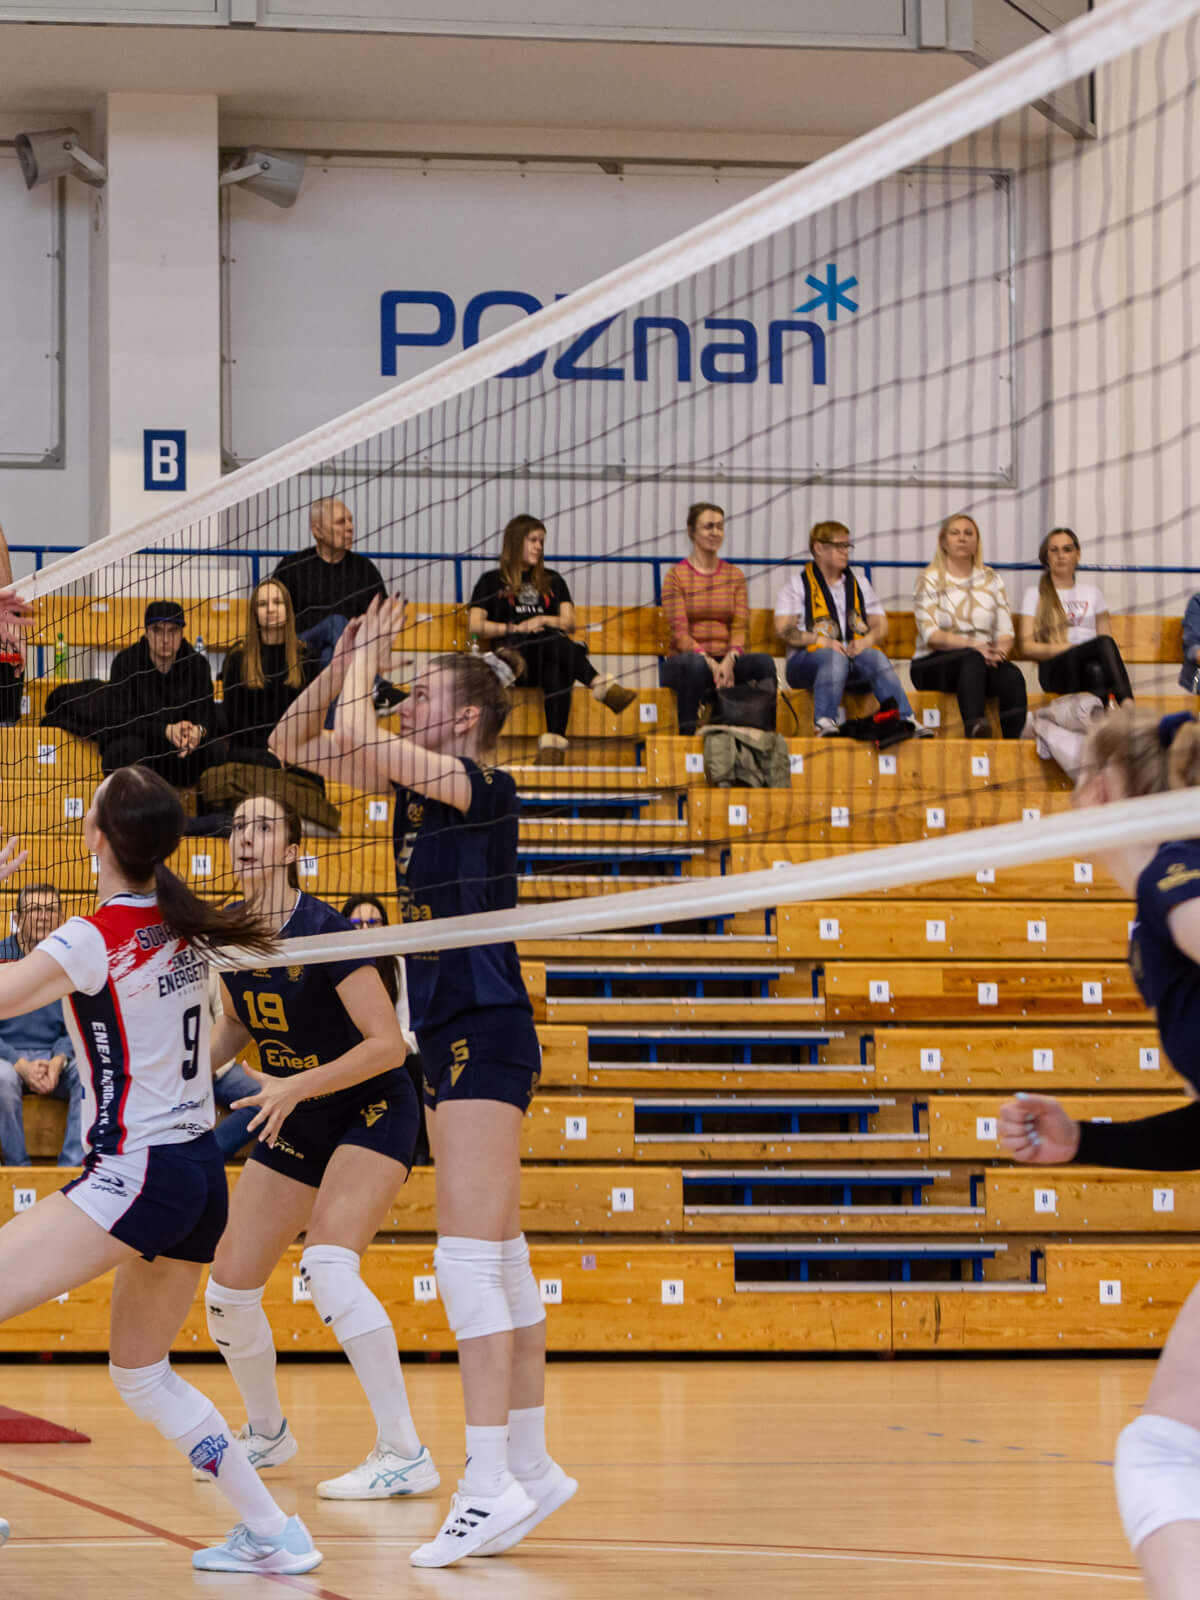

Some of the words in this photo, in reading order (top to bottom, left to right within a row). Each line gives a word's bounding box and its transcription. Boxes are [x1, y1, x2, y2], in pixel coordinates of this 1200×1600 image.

[243, 990, 289, 1032] 19
[91, 1021, 112, 1064] ENEA
[182, 1004, 201, 1081] 9
[450, 1038, 470, 1063] 5
[266, 1049, 320, 1069] Enea
[573, 1121, 580, 1132] 9
[984, 1121, 990, 1133] 8
[20, 1193, 32, 1204] 14
[619, 1192, 626, 1203] 9
[1042, 1194, 1048, 1204] 8
[1160, 1192, 1167, 1205] 7
[420, 1280, 431, 1292] 11
[545, 1284, 557, 1295] 10
[669, 1284, 676, 1295] 9
[1107, 1284, 1113, 1296] 8
